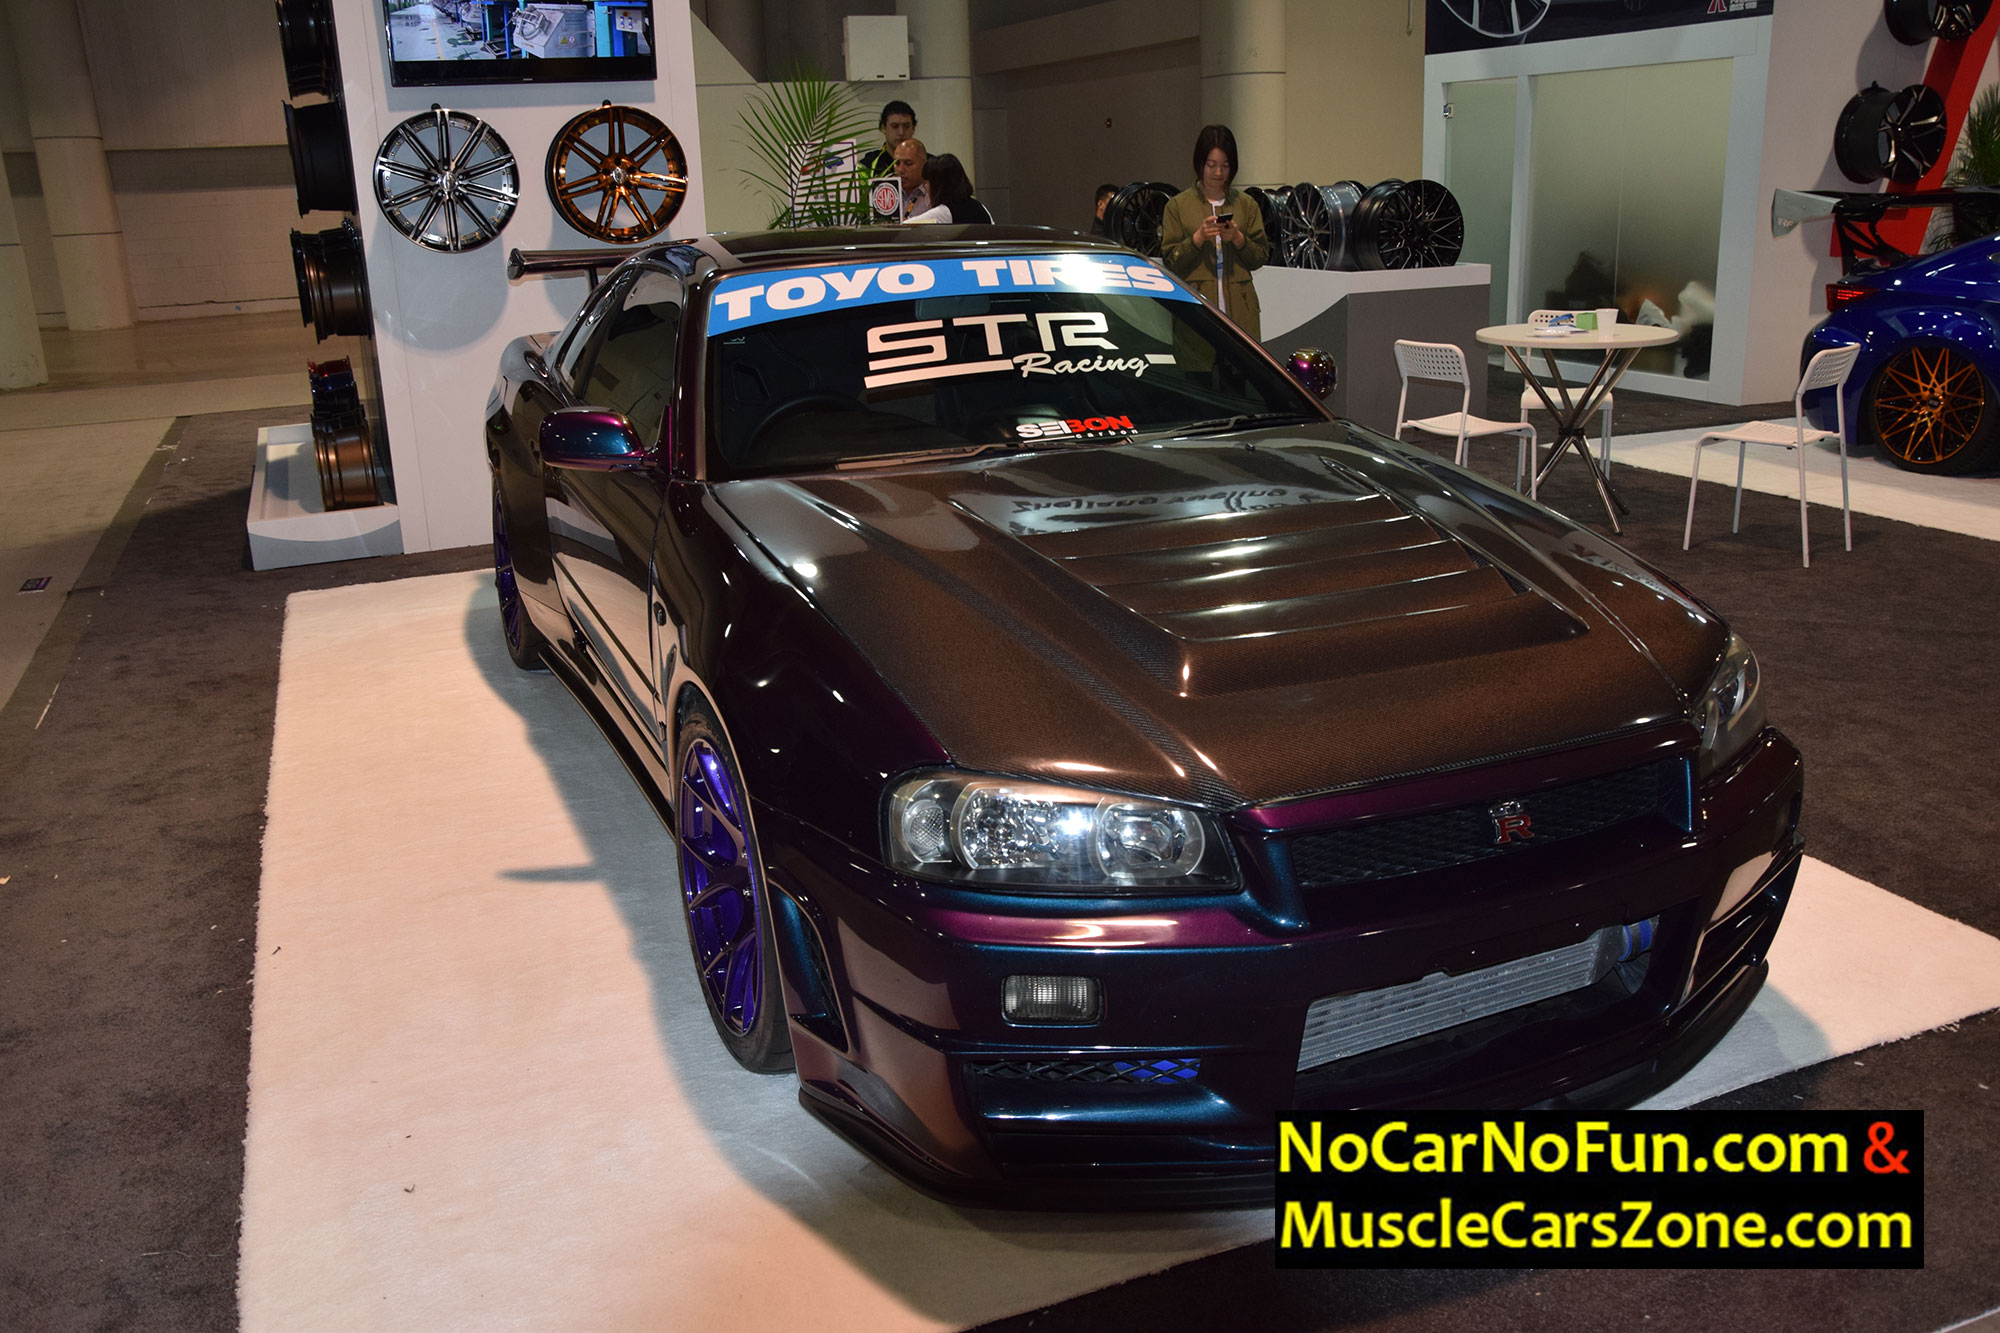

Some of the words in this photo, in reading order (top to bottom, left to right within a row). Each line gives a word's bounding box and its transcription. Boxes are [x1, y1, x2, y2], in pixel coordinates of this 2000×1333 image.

[714, 263, 935, 321] TOYO
[962, 259, 1175, 292] TIRES
[866, 312, 1119, 371] STR
[1012, 352, 1150, 378] Racing
[1015, 415, 1135, 438] SEIBON
[1074, 428, 1139, 440] carbon
